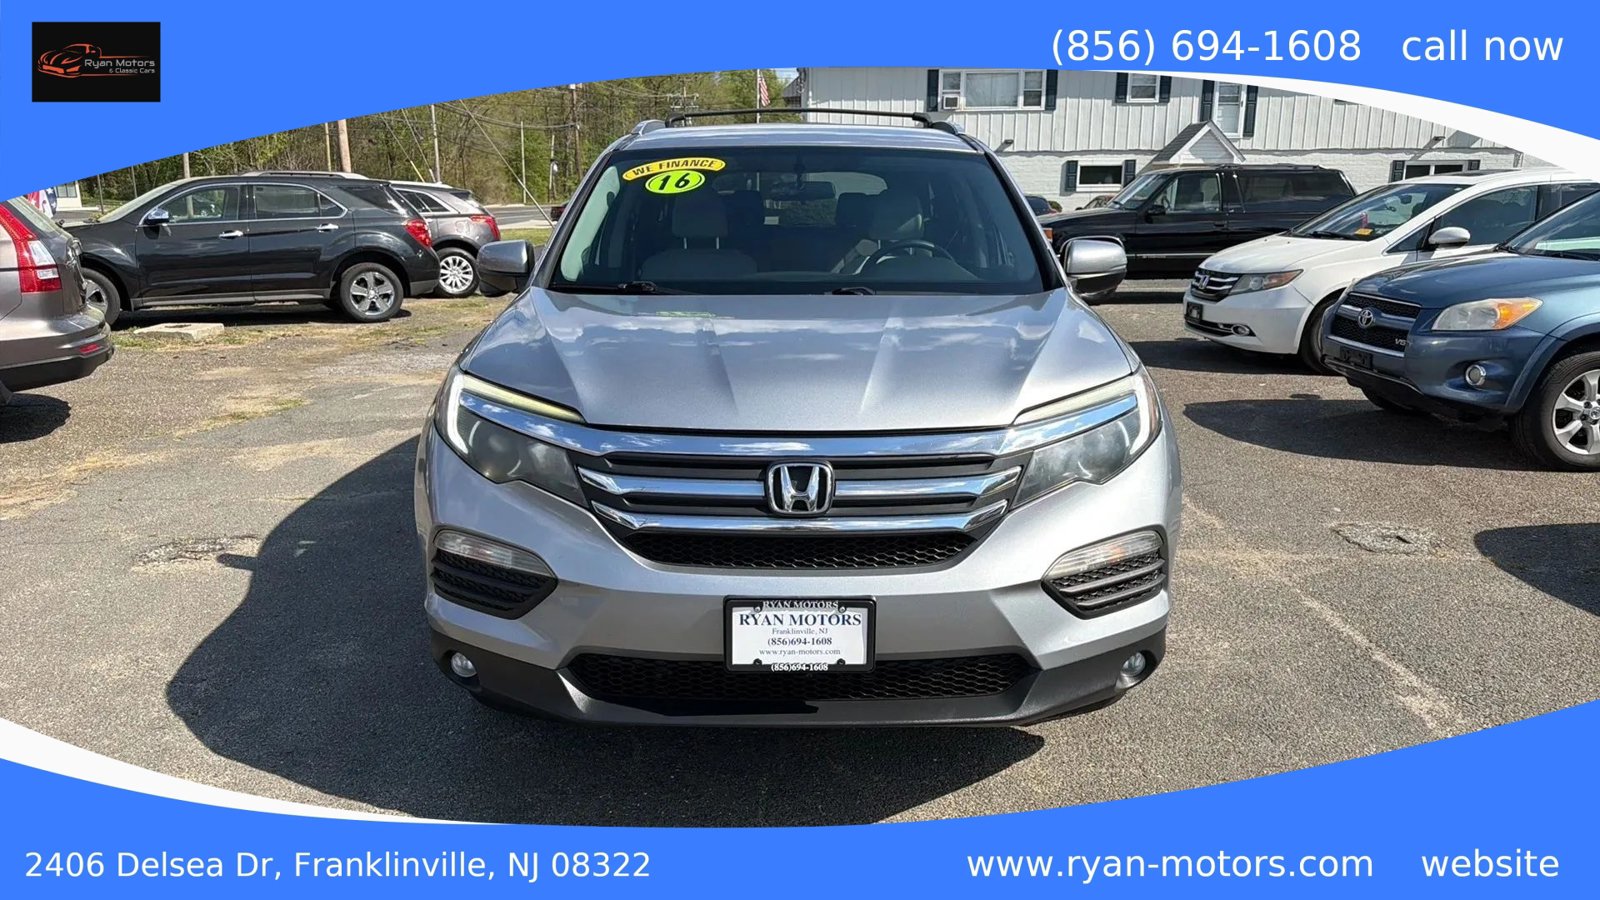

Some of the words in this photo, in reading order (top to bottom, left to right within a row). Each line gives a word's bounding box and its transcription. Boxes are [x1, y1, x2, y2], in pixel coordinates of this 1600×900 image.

[632, 165, 654, 176] WE
[659, 160, 717, 170] FINANCE
[658, 172, 691, 191] 16
[762, 601, 792, 609] RYAN
[794, 601, 839, 609] MOTORS
[739, 613, 784, 626] RYAN
[789, 613, 862, 626] MOTORS
[772, 628, 818, 636] Franklinville,
[767, 637, 832, 647] (856)694-1608
[759, 649, 841, 657] www.ryan-motors.com
[771, 663, 829, 672] (856)694-1608
